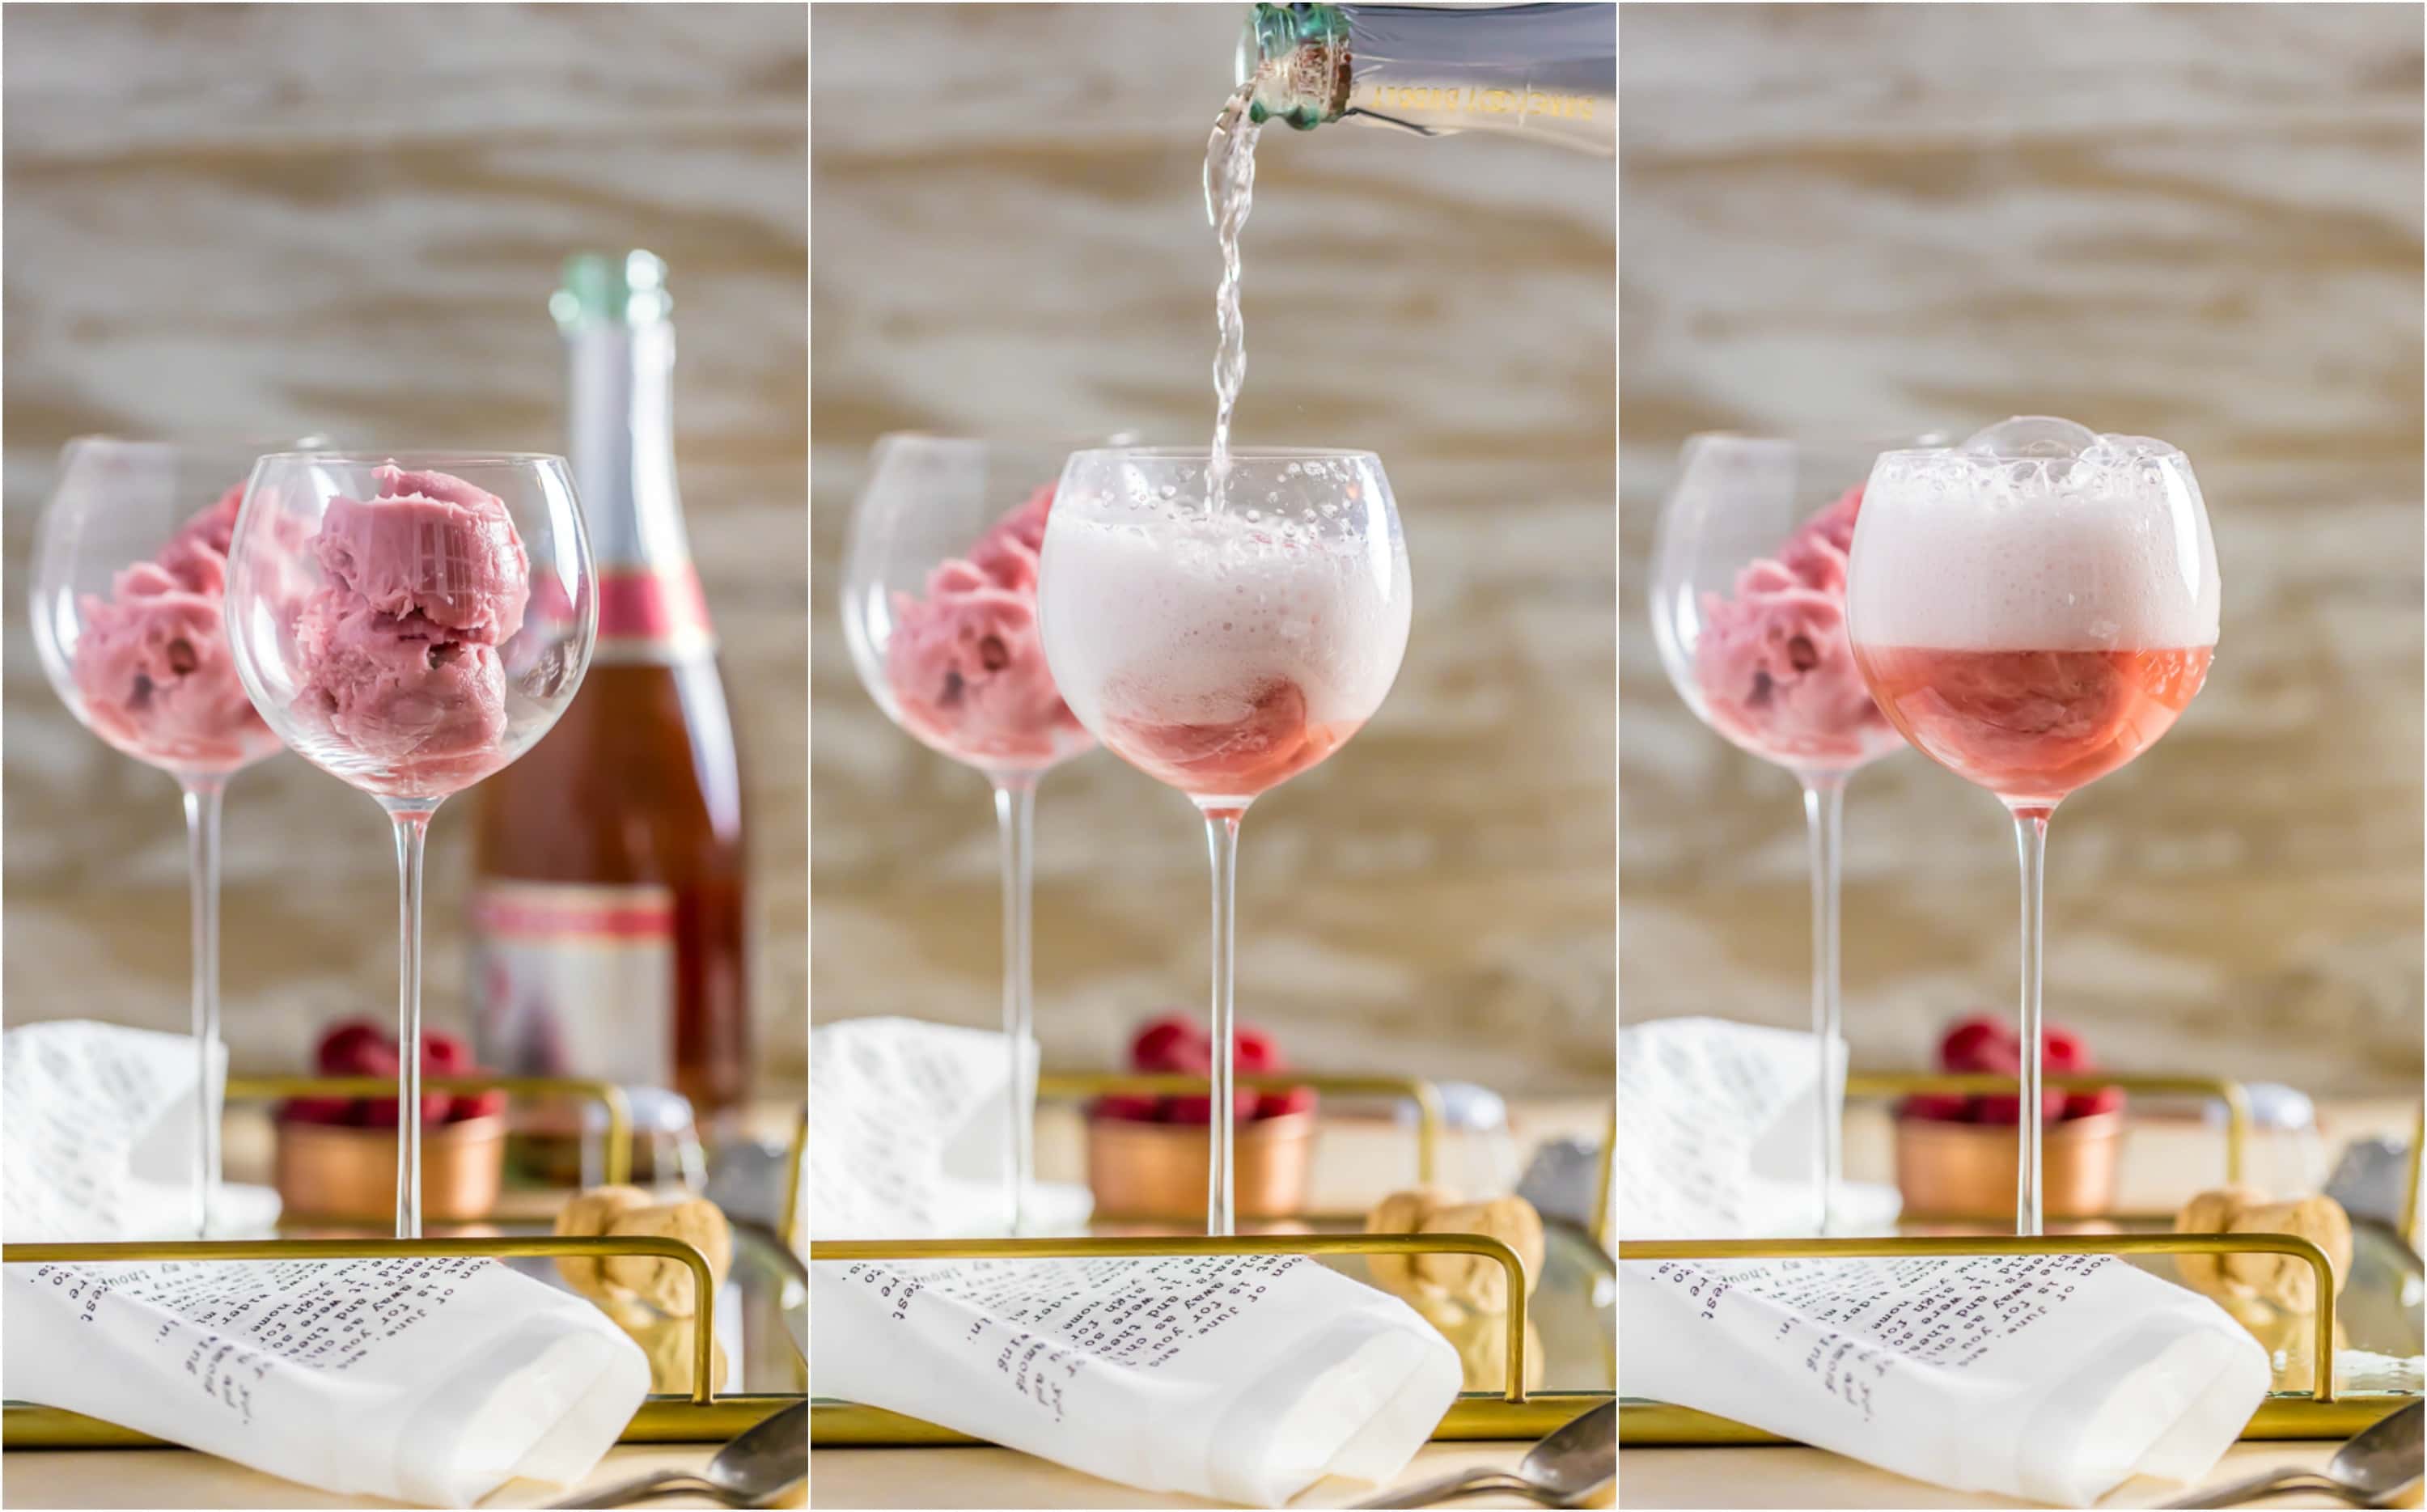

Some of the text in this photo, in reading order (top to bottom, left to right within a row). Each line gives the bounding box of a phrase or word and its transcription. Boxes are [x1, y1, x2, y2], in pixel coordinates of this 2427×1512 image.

[372, 1285, 412, 1312] away
[1184, 1282, 1224, 1310] away
[1993, 1282, 2032, 1309] away
[301, 1300, 342, 1327] were
[382, 1303, 409, 1325] for
[1112, 1298, 1154, 1324] were
[1193, 1301, 1222, 1324] for
[1921, 1298, 1963, 1324] were
[1963, 1315, 1984, 1329] as
[2002, 1301, 2030, 1322] for
[260, 1323, 286, 1342] for
[343, 1318, 364, 1332] as
[1071, 1320, 1099, 1340] for
[1154, 1315, 1176, 1330] as
[1880, 1319, 1907, 1340] for
